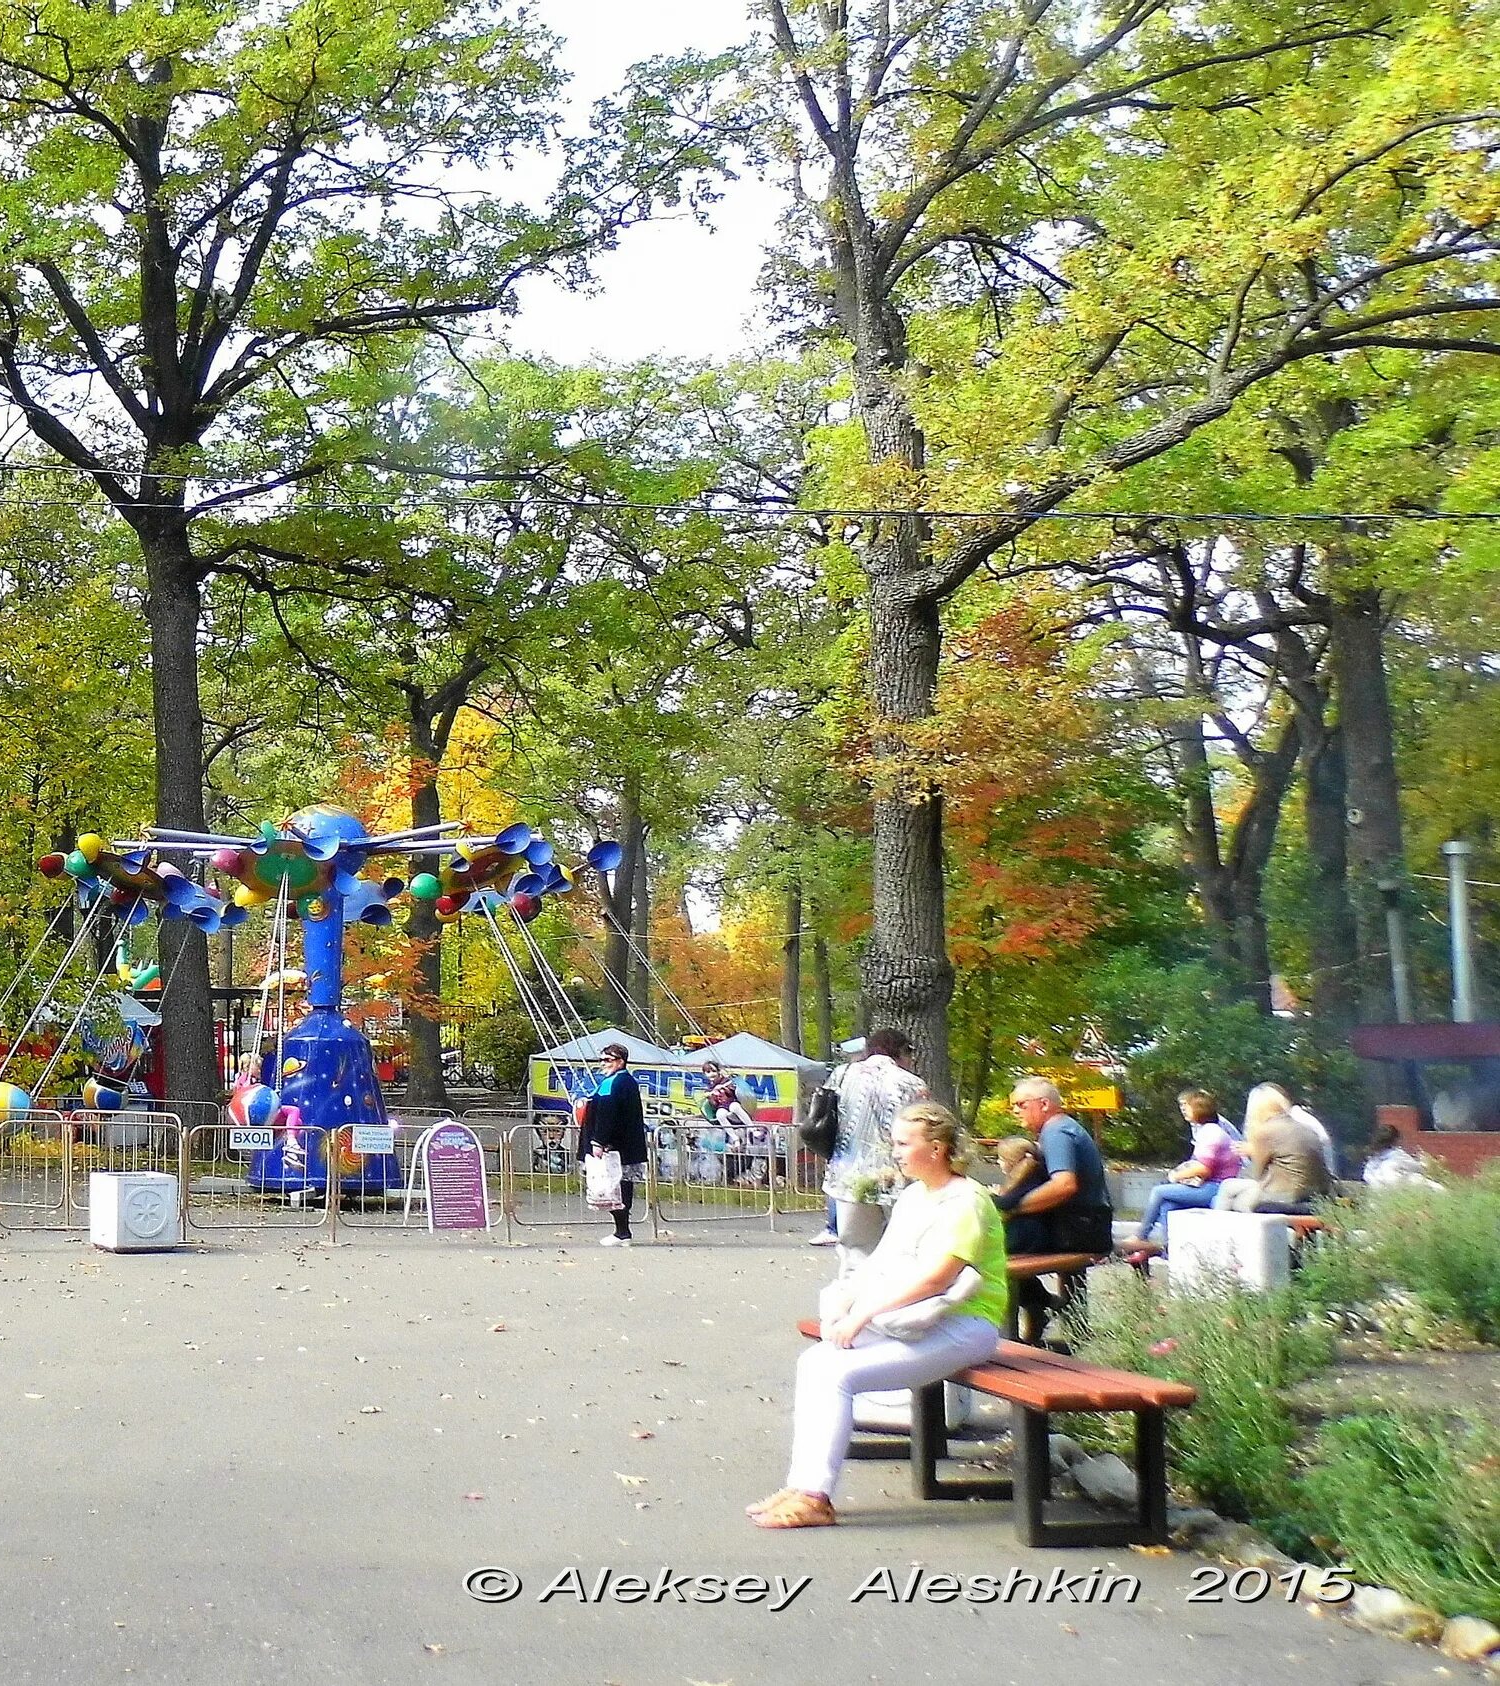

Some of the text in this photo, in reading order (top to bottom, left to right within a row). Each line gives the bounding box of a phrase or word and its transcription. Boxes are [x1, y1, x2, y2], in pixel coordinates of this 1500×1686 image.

[548, 1065, 778, 1101] ААГРМ
[646, 1102, 672, 1116] 50
[233, 1132, 271, 1146] ВХОД
